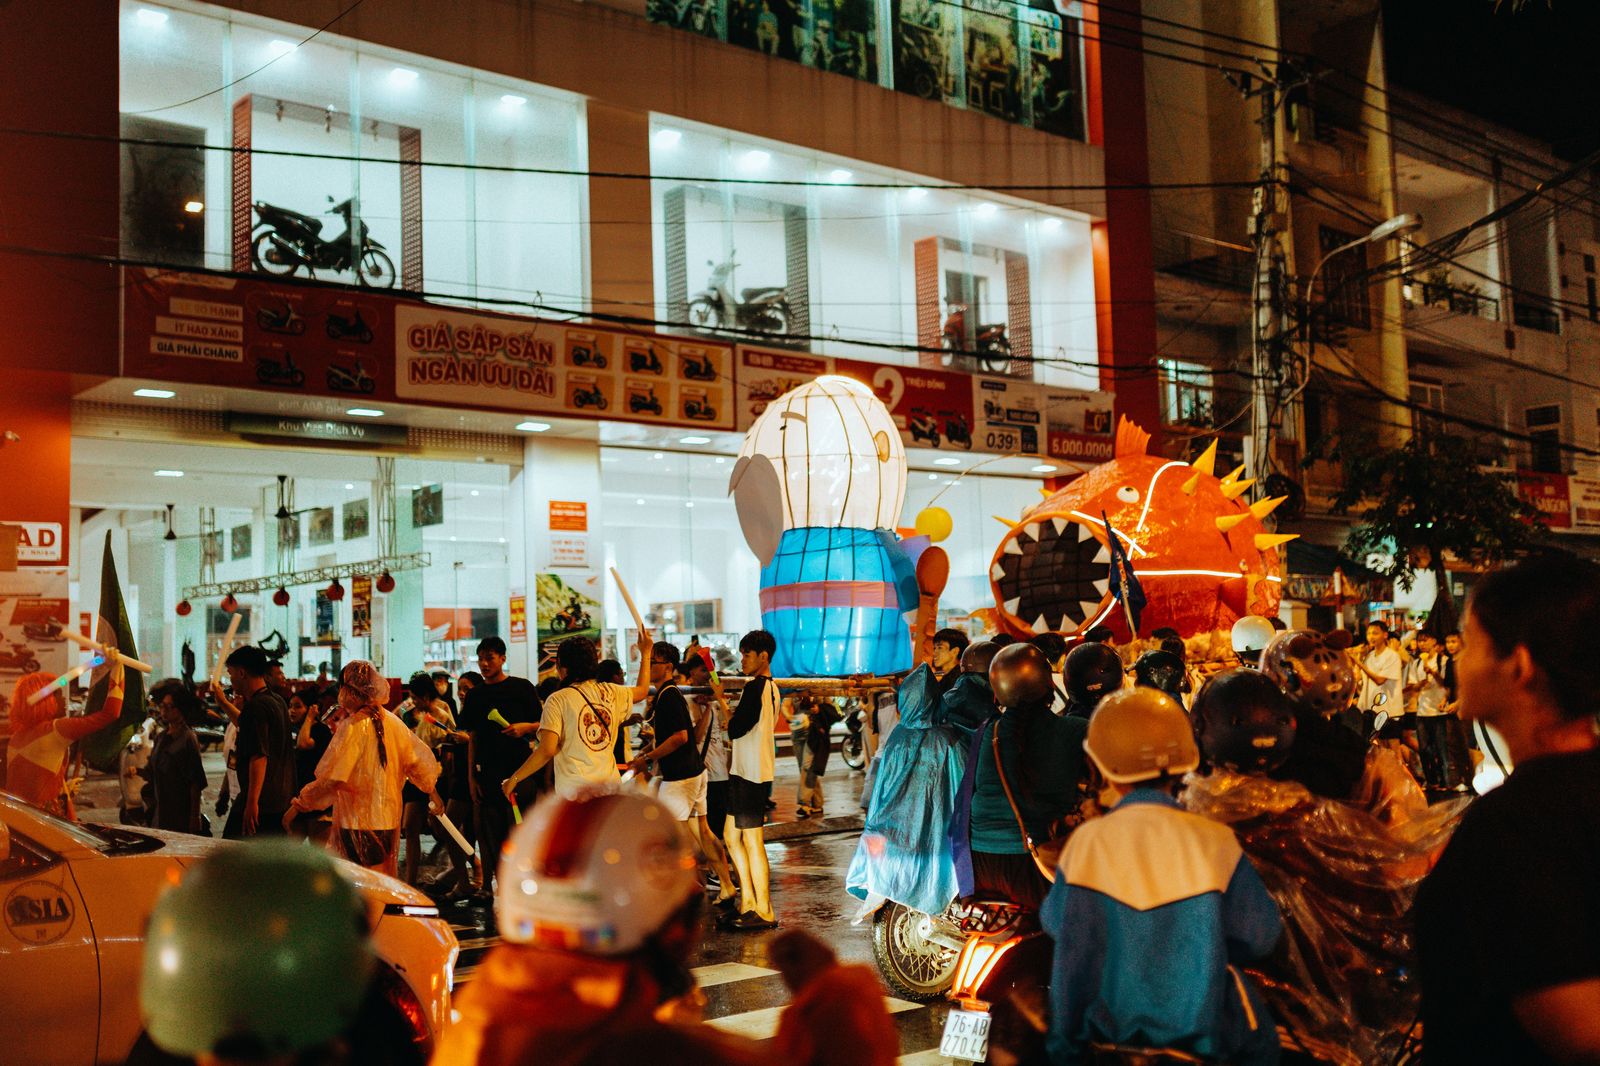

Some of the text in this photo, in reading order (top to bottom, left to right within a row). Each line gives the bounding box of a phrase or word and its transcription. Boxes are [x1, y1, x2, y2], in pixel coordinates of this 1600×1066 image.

[410, 324, 450, 350] GIÁ
[456, 327, 503, 357] SẬP
[518, 368, 554, 394] ĐÃI
[279, 422, 300, 432] Khu
